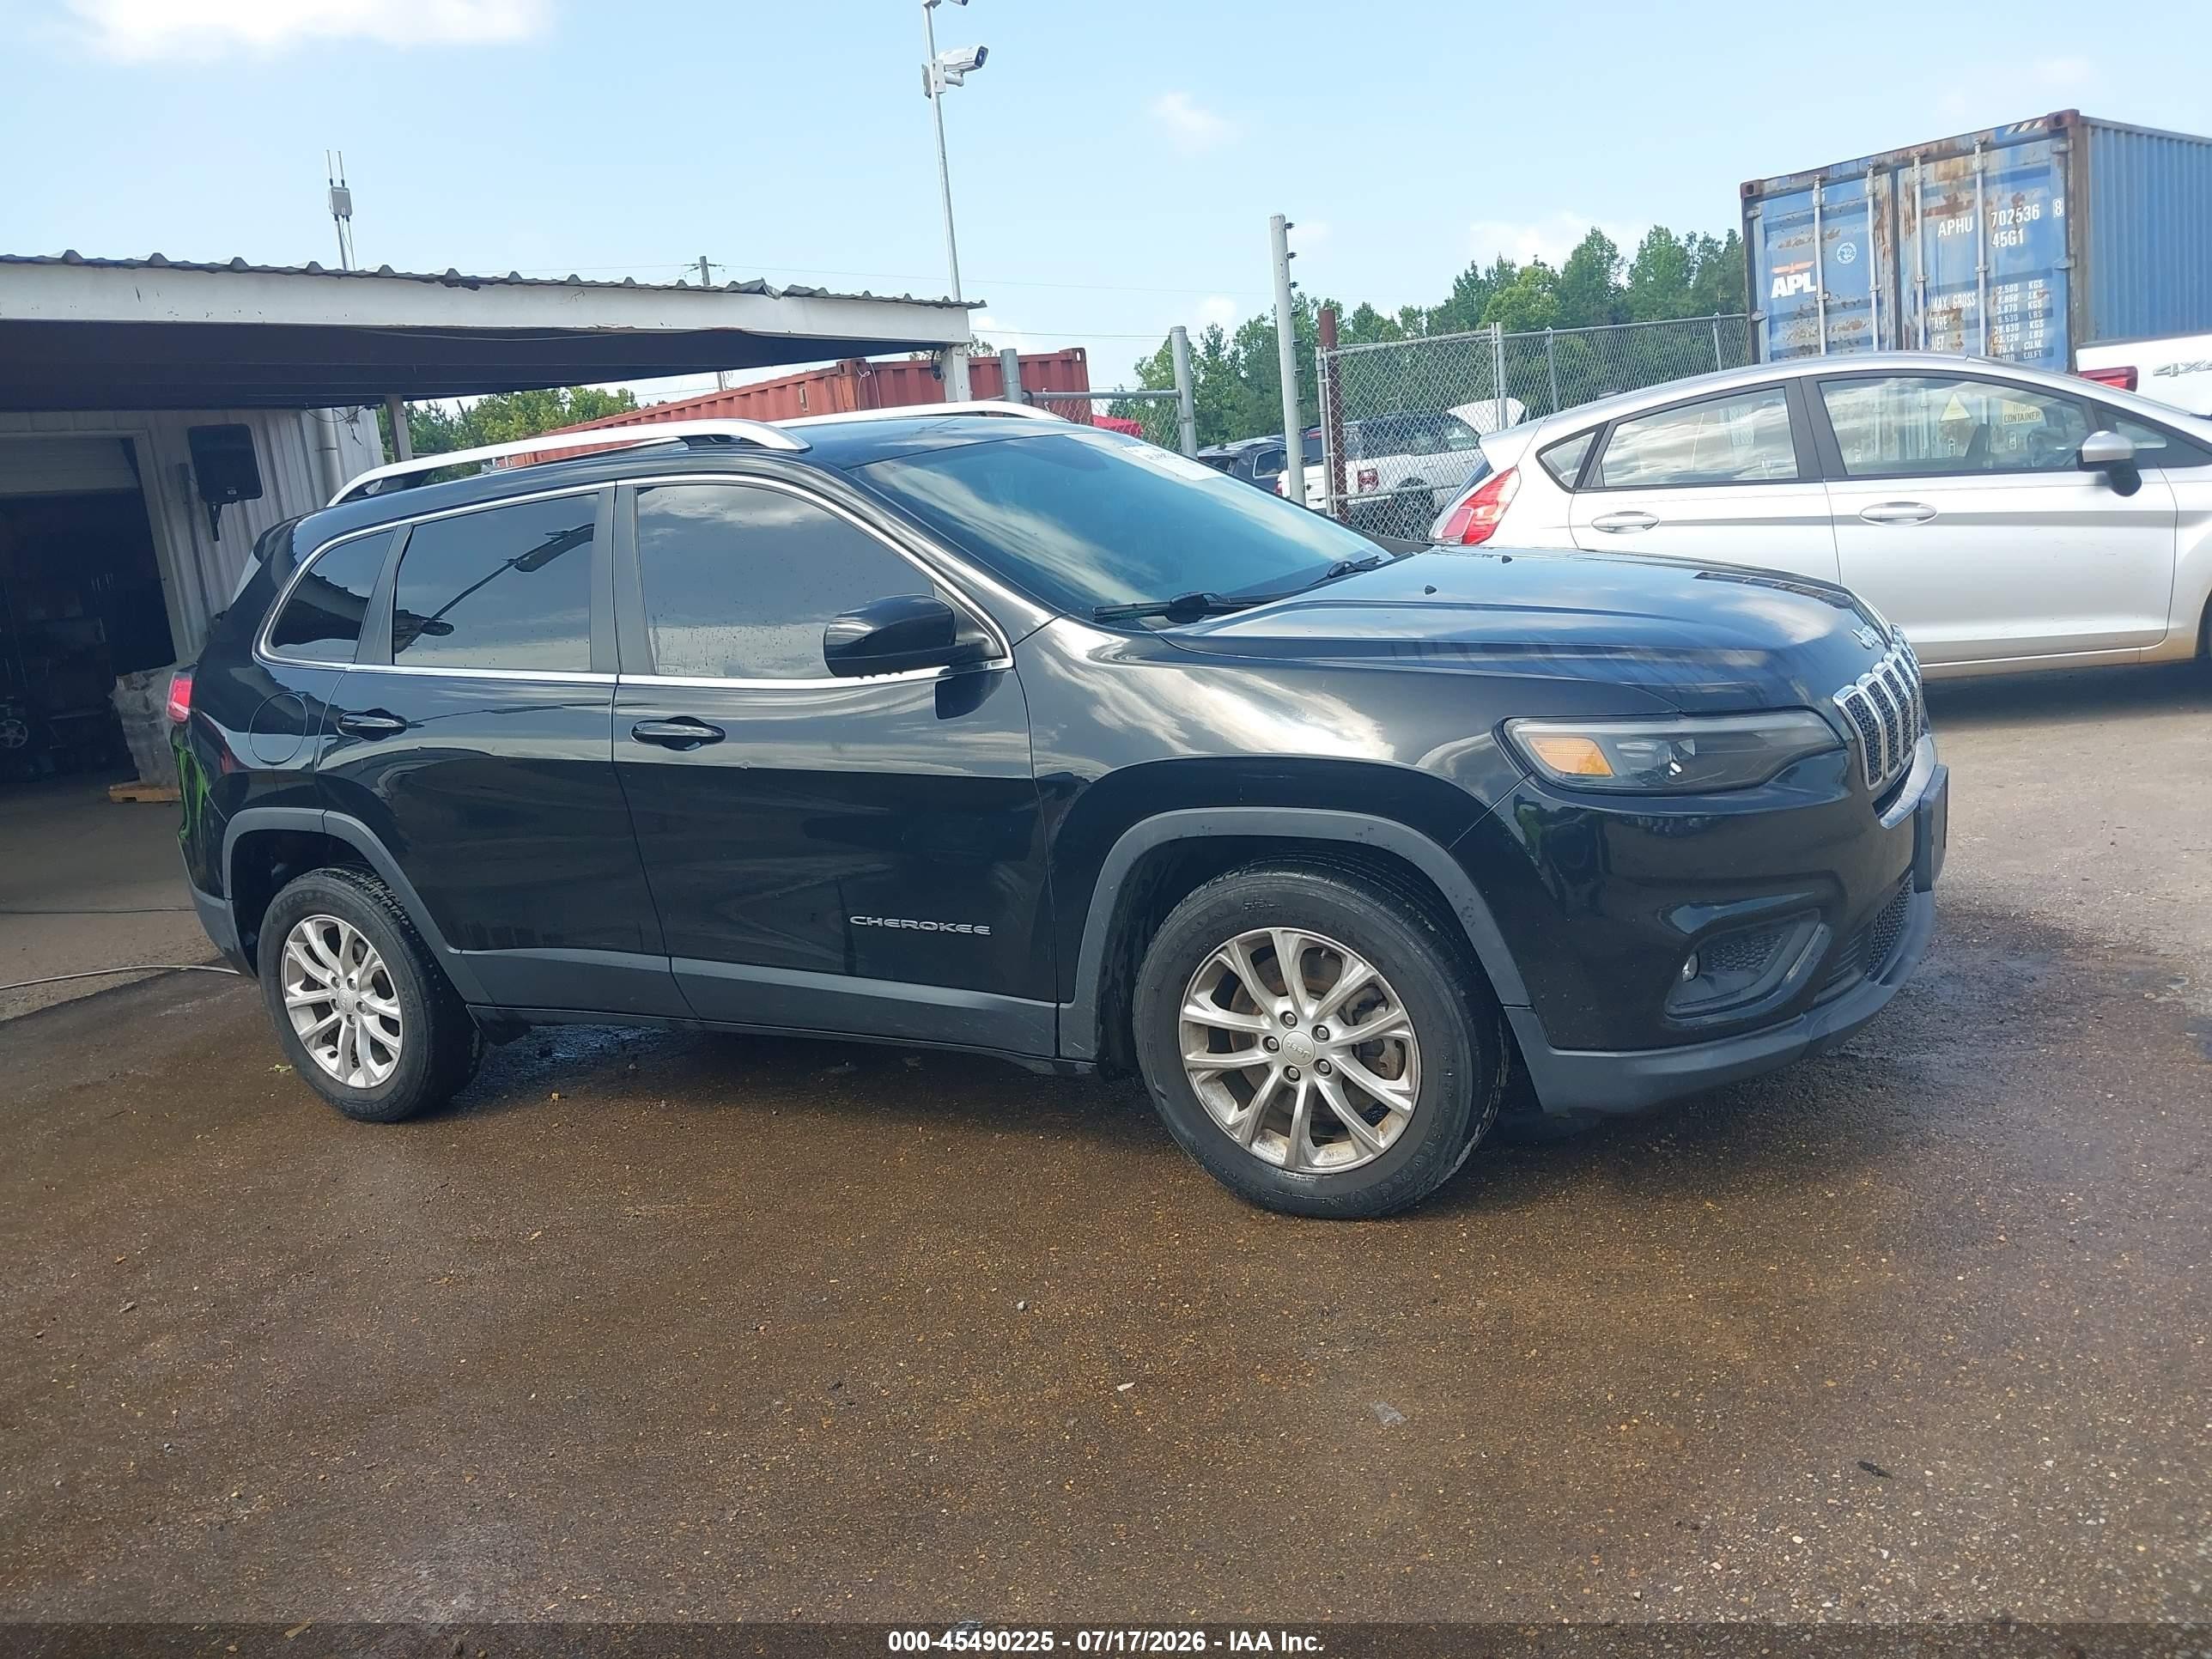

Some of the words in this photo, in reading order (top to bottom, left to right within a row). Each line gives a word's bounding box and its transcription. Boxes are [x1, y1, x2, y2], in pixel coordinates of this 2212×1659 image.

[1937, 216, 1973, 238] APHU
[1990, 204, 2040, 228] 702536
[2054, 199, 2063, 216] 8
[1992, 228, 2024, 247] 45G1
[1771, 271, 1817, 298] APL
[1953, 292, 1976, 309] GROSS
[2028, 279, 2044, 289] KGS
[1930, 315, 1948, 331] TARE
[2027, 300, 2042, 310] KGS
[2027, 309, 2043, 319] LBS
[2029, 319, 2044, 330] KGS
[2029, 330, 2044, 340] LBS
[2003, 411, 2040, 423] CONTAINER
[849, 915, 991, 935] CHEROKEE
